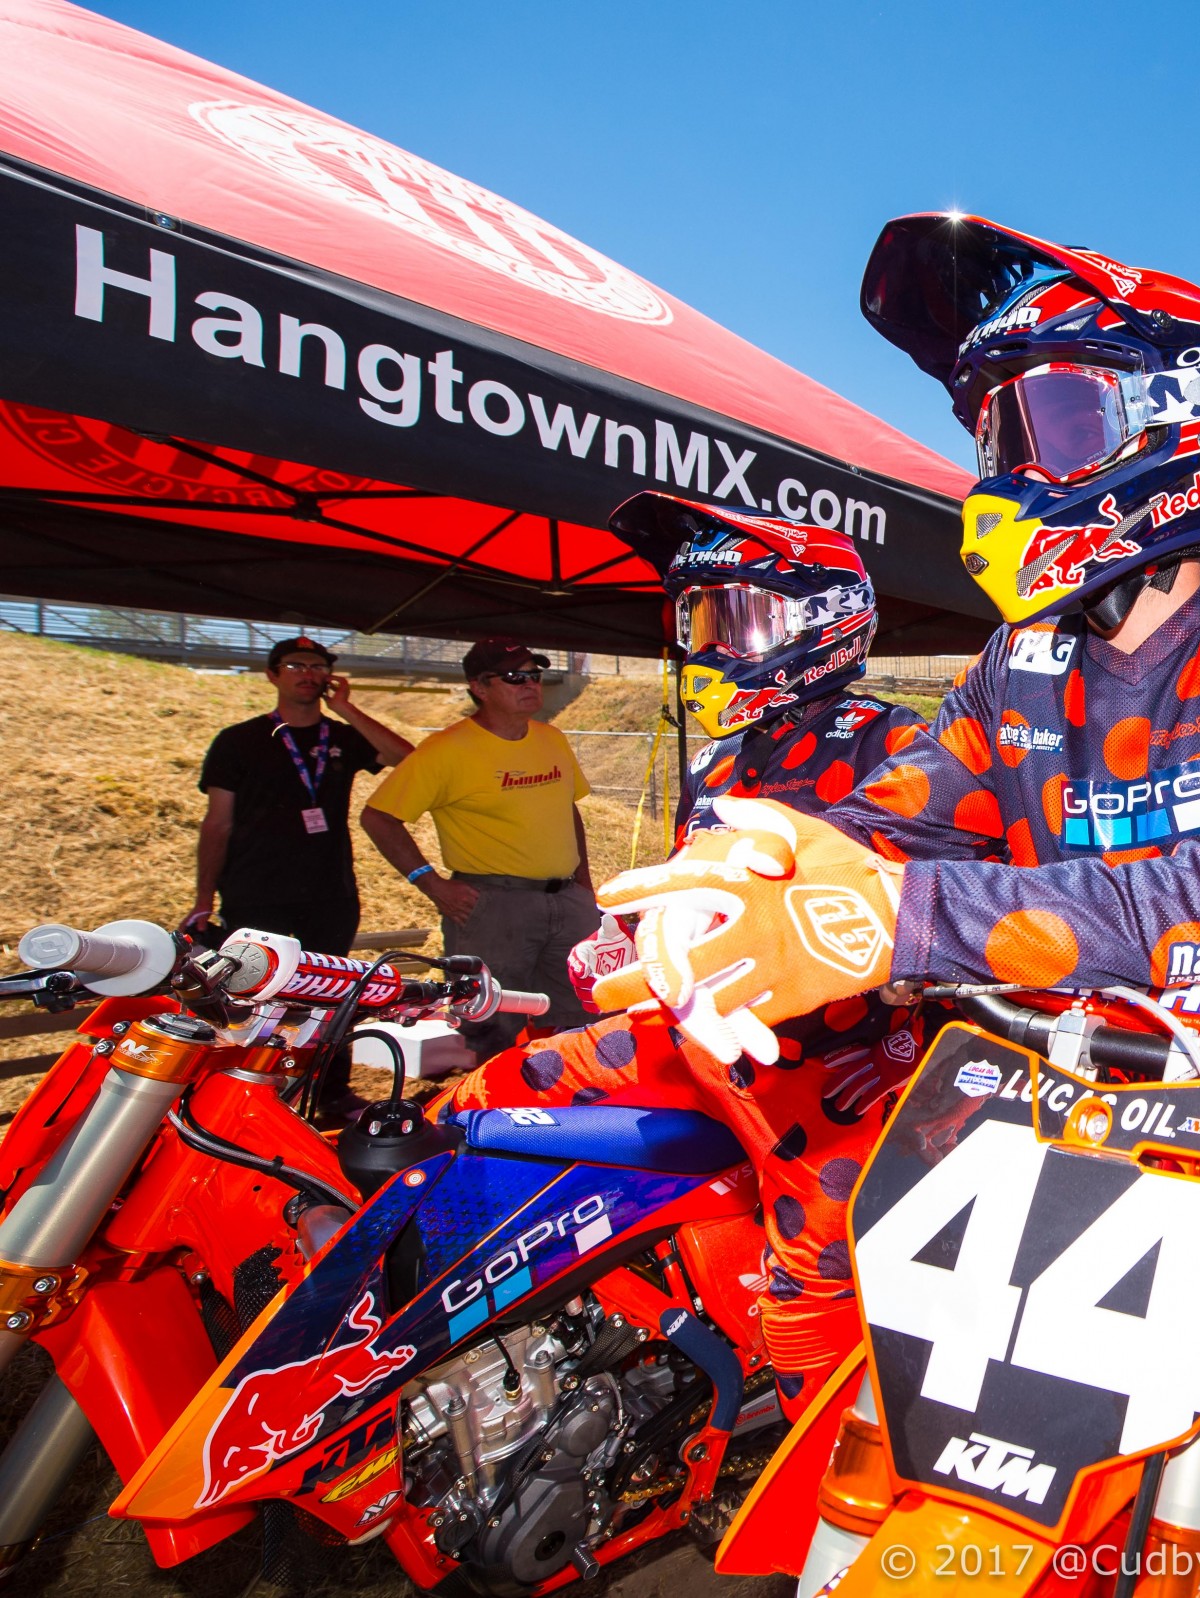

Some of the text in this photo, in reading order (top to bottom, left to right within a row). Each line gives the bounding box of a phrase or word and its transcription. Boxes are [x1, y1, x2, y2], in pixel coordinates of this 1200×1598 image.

[74, 224, 886, 546] HangtownMX.com
[803, 635, 862, 687] Red Bull
[1032, 727, 1063, 747] baker
[441, 1194, 604, 1314] GoPro
[666, 1310, 689, 1337] KTM
[744, 1403, 776, 1421] brembo
[293, 1406, 394, 1498] KTM
[932, 1431, 1058, 1505] KTM
